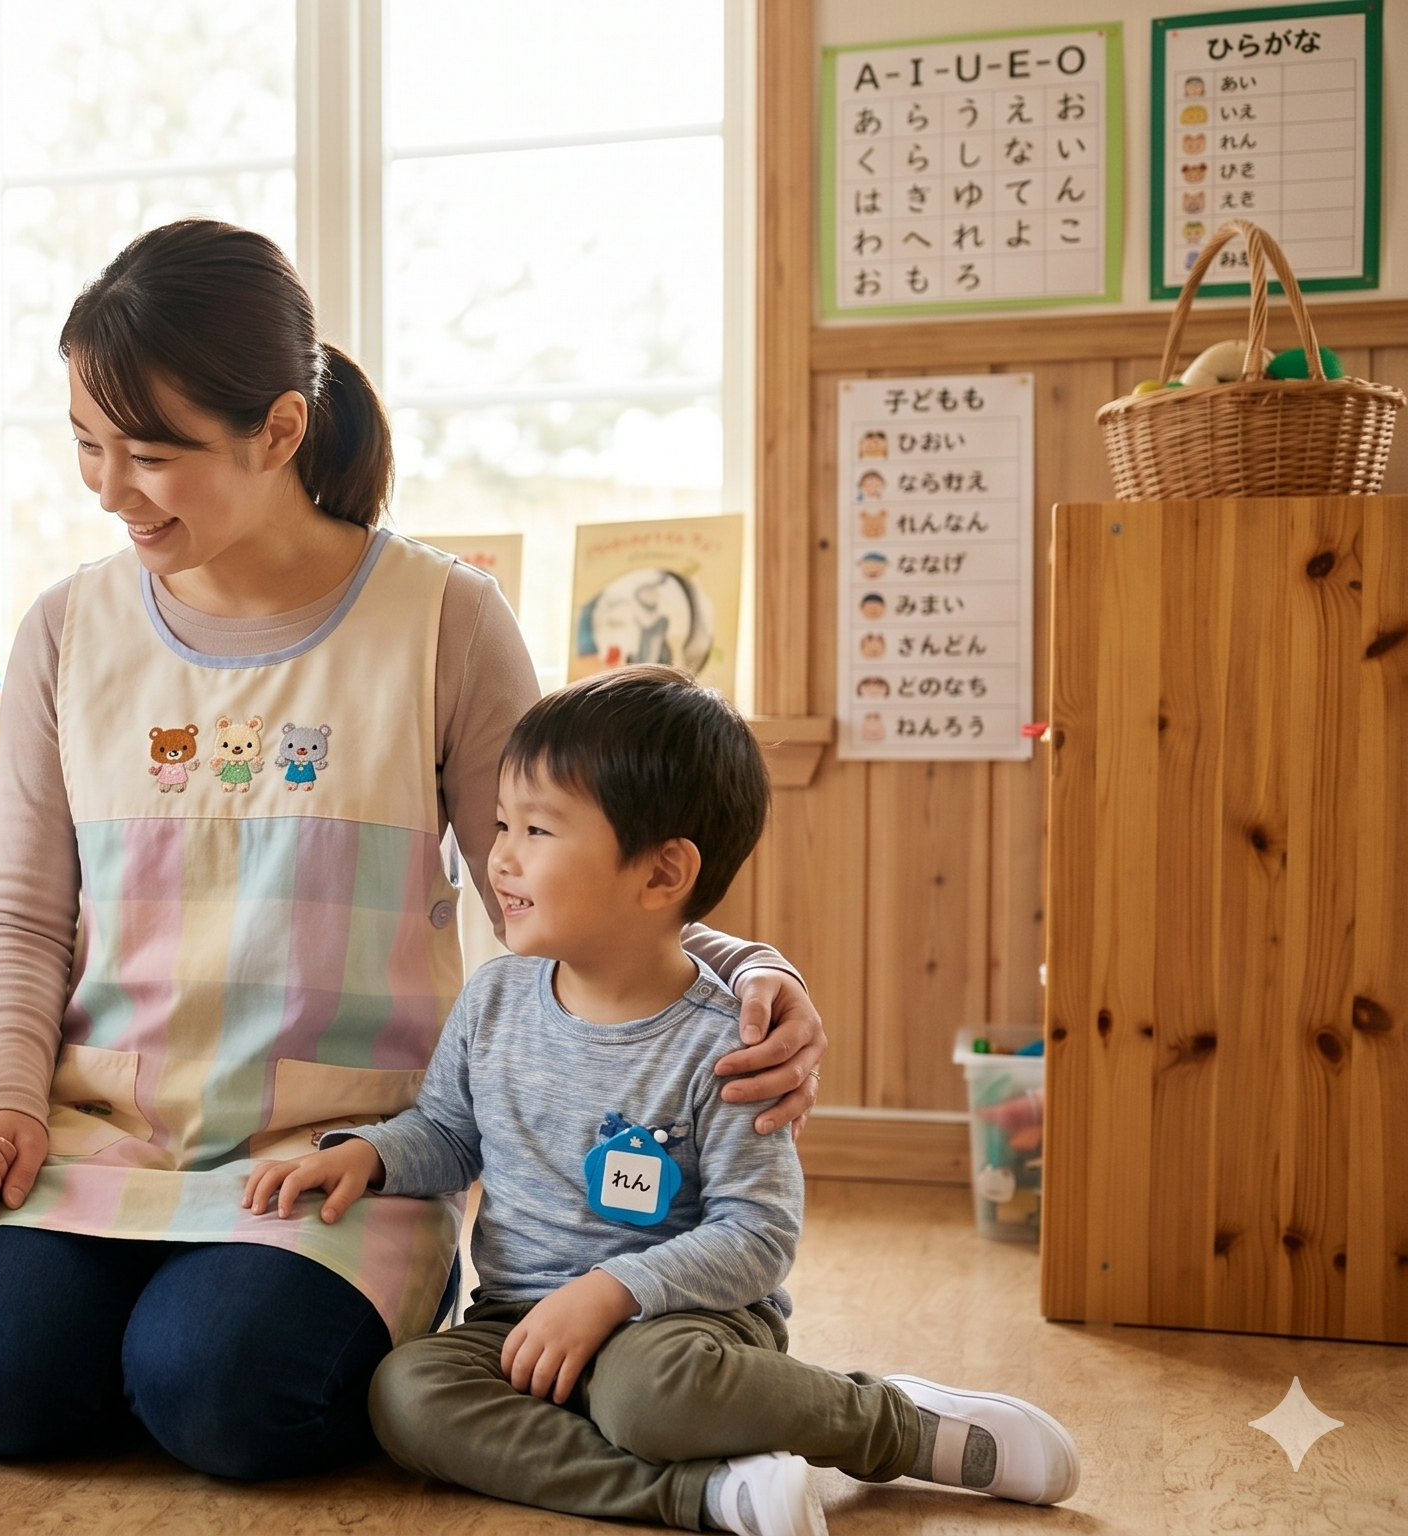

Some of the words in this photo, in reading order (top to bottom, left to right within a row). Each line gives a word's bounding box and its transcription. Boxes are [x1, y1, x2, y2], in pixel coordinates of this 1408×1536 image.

[1207, 28, 1322, 61] ひらがな
[854, 44, 1087, 92] A-I-U-E-O
[1220, 75, 1257, 92] あい
[1220, 103, 1256, 121] いえ
[1220, 132, 1257, 150] れん
[885, 387, 985, 414] 子どもも
[897, 432, 965, 454] ひおい
[895, 594, 964, 616] みまい
[611, 1169, 651, 1193] れん
